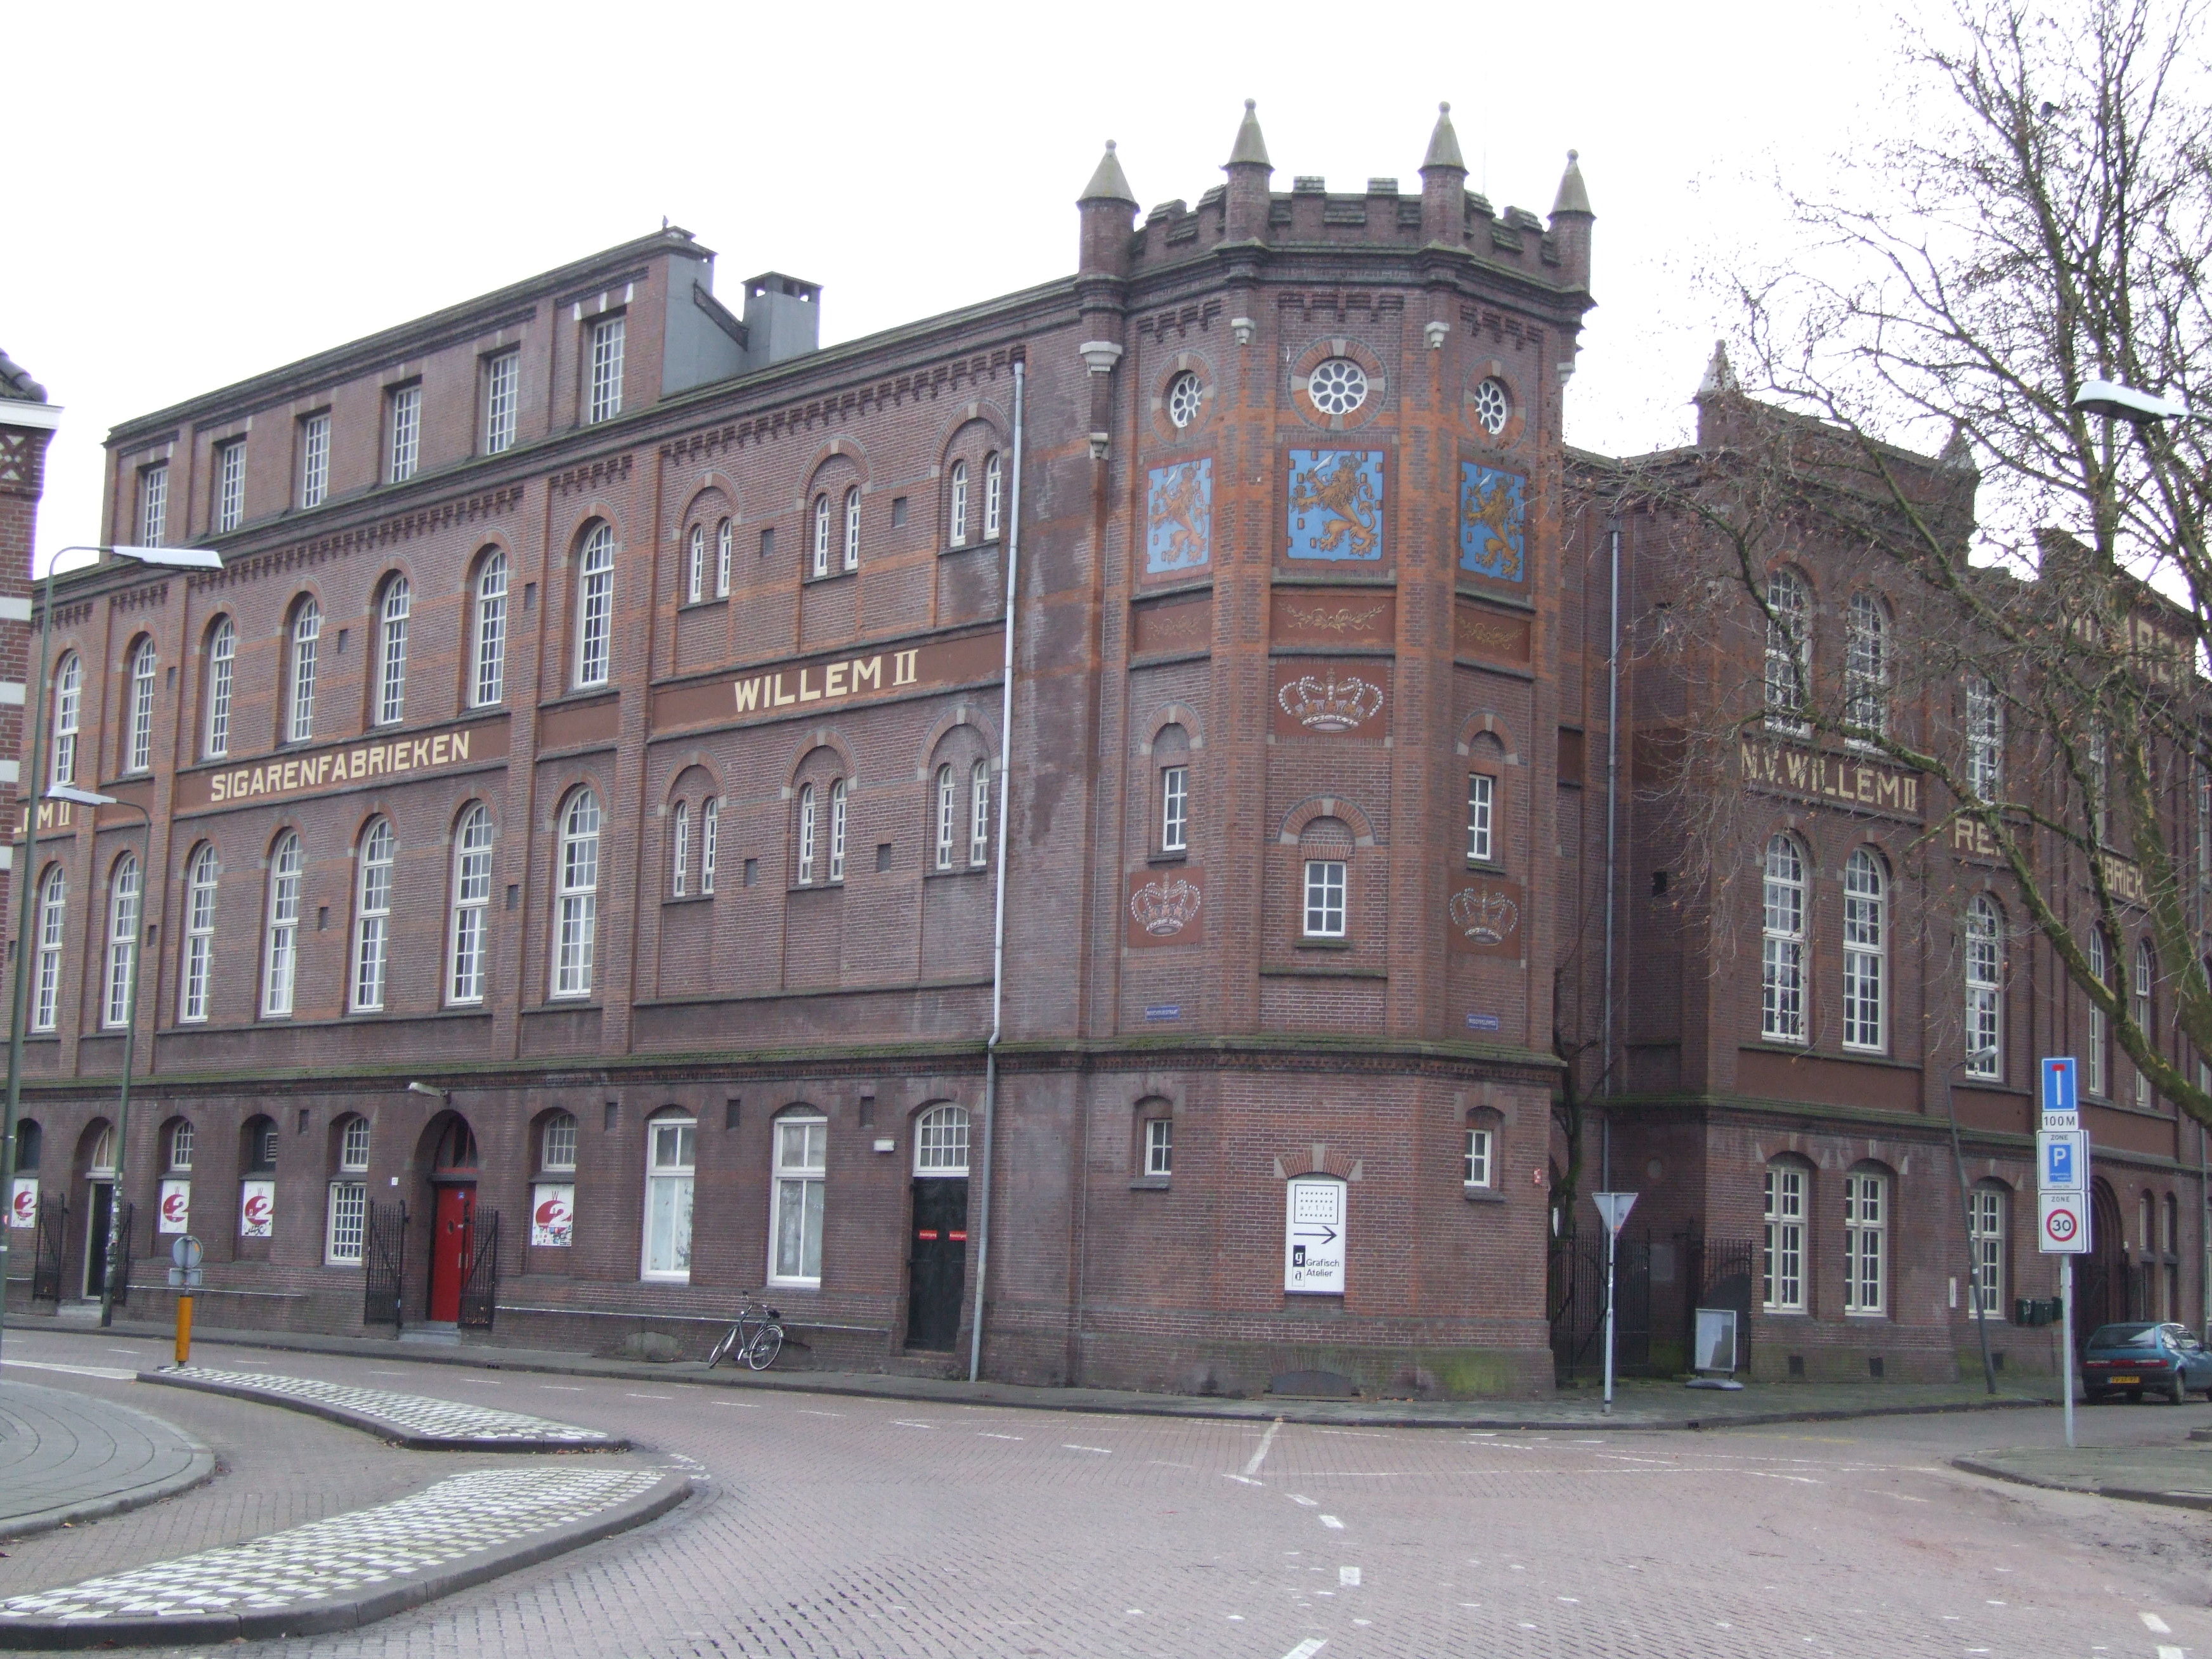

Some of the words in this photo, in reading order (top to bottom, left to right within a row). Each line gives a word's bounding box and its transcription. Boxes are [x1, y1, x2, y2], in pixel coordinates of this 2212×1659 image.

[734, 656, 882, 712] WILLEM
[893, 649, 918, 686] II
[211, 731, 469, 802] SIGARENFABRIEKEN
[1786, 751, 1899, 808] WILLEM
[1903, 778, 1916, 812] II
[58, 801, 70, 826] II
[2054, 1147, 2066, 1167] P
[256, 1198, 274, 1220] 2
[549, 1203, 573, 1228] 2
[2052, 1220, 2071, 1232] 30
[1306, 1258, 1339, 1267] Grafisch
[1306, 1268, 1332, 1277] Atelier
